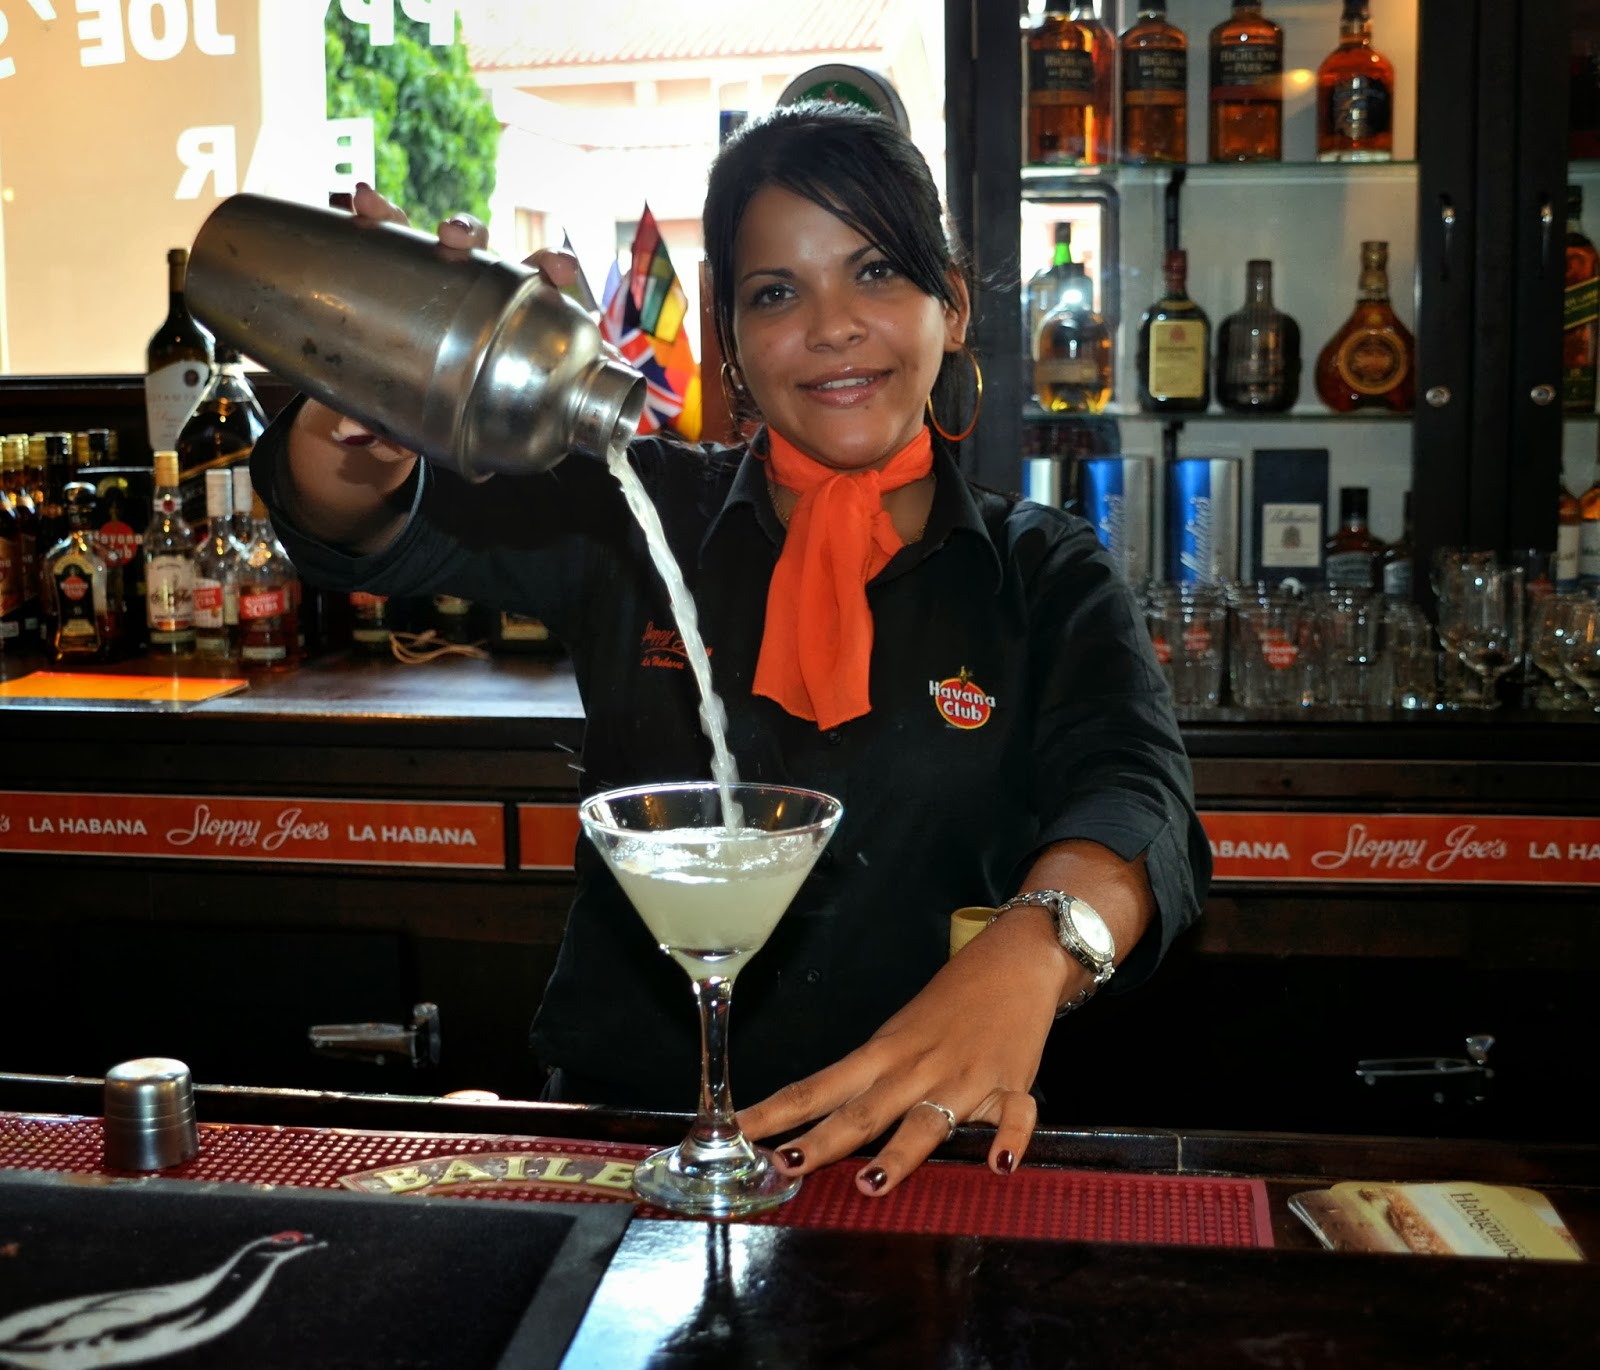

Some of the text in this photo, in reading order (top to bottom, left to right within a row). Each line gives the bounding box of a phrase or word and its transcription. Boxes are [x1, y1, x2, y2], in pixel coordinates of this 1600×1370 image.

[928, 680, 997, 708] Havana
[943, 700, 983, 722] Club
[28, 816, 55, 834] LA
[58, 817, 148, 836] HABANA
[166, 803, 262, 848] Sloppy
[261, 807, 331, 852] Joe's
[347, 824, 377, 842] LA
[380, 825, 478, 846] HABANA
[1209, 839, 1291, 861] BANA
[1310, 822, 1429, 870] Sloppy
[1425, 823, 1509, 873] Joe's
[1528, 841, 1563, 860] LA
[378, 1156, 634, 1194] BAILE
